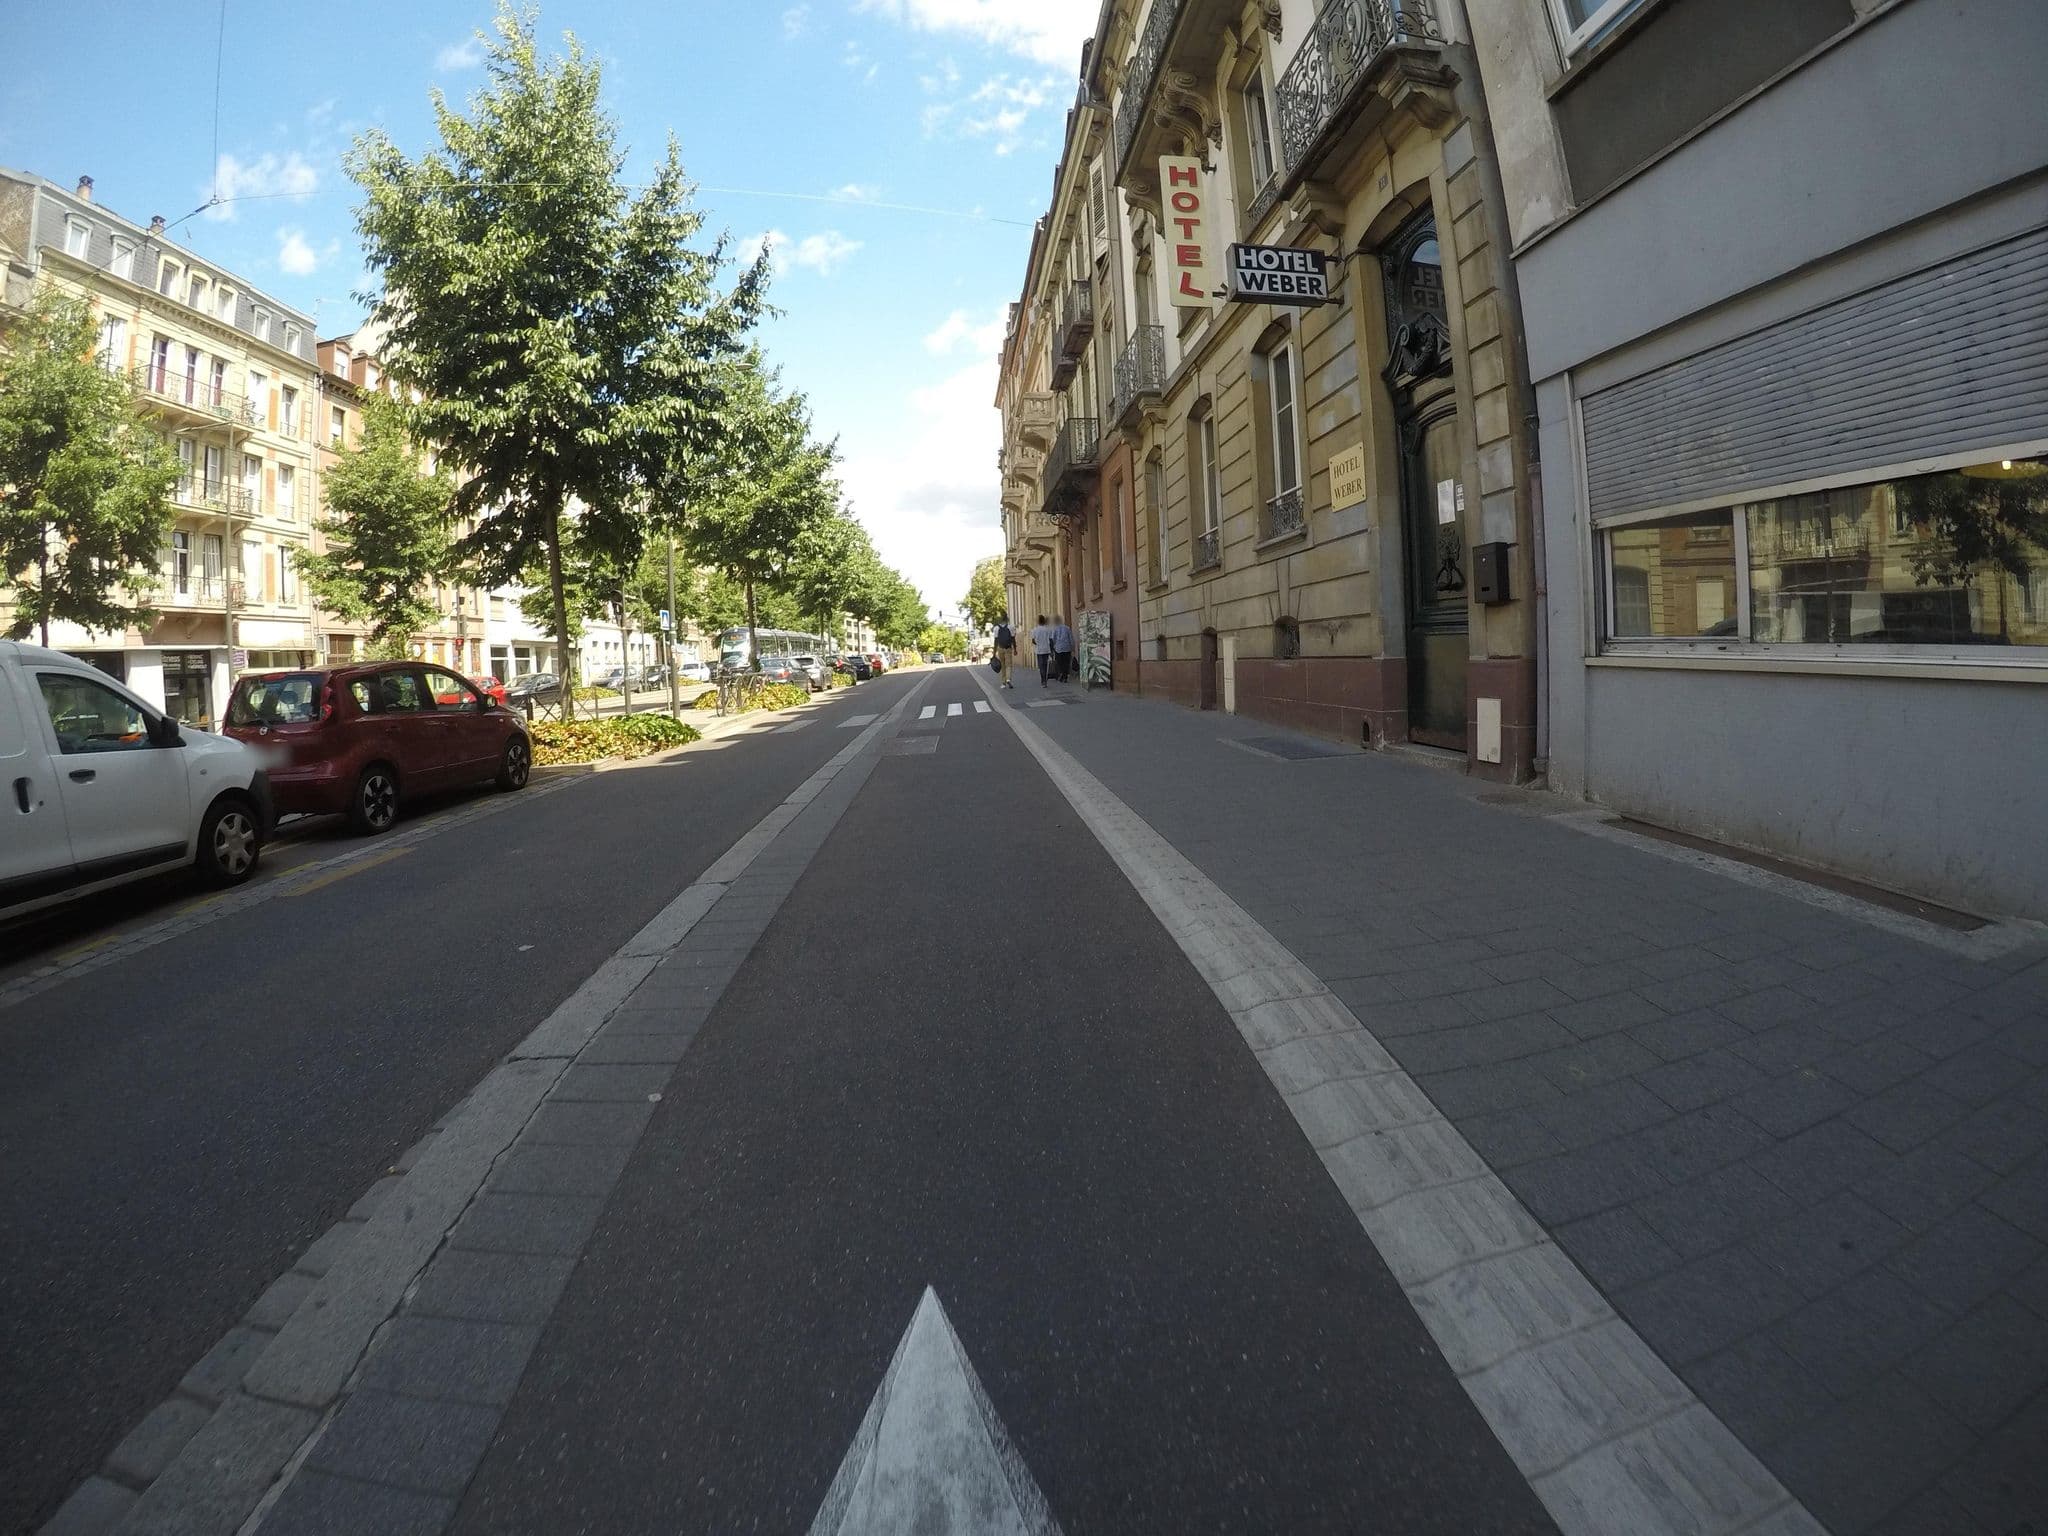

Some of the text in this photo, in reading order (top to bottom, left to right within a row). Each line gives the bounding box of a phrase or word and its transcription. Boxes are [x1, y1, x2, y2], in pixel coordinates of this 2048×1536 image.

[1168, 165, 1204, 299] HOTEL
[1238, 248, 1319, 273] HOTEL
[1240, 272, 1324, 296] WEBER
[1333, 456, 1361, 479] HOTEL
[1334, 478, 1363, 500] WEBER
